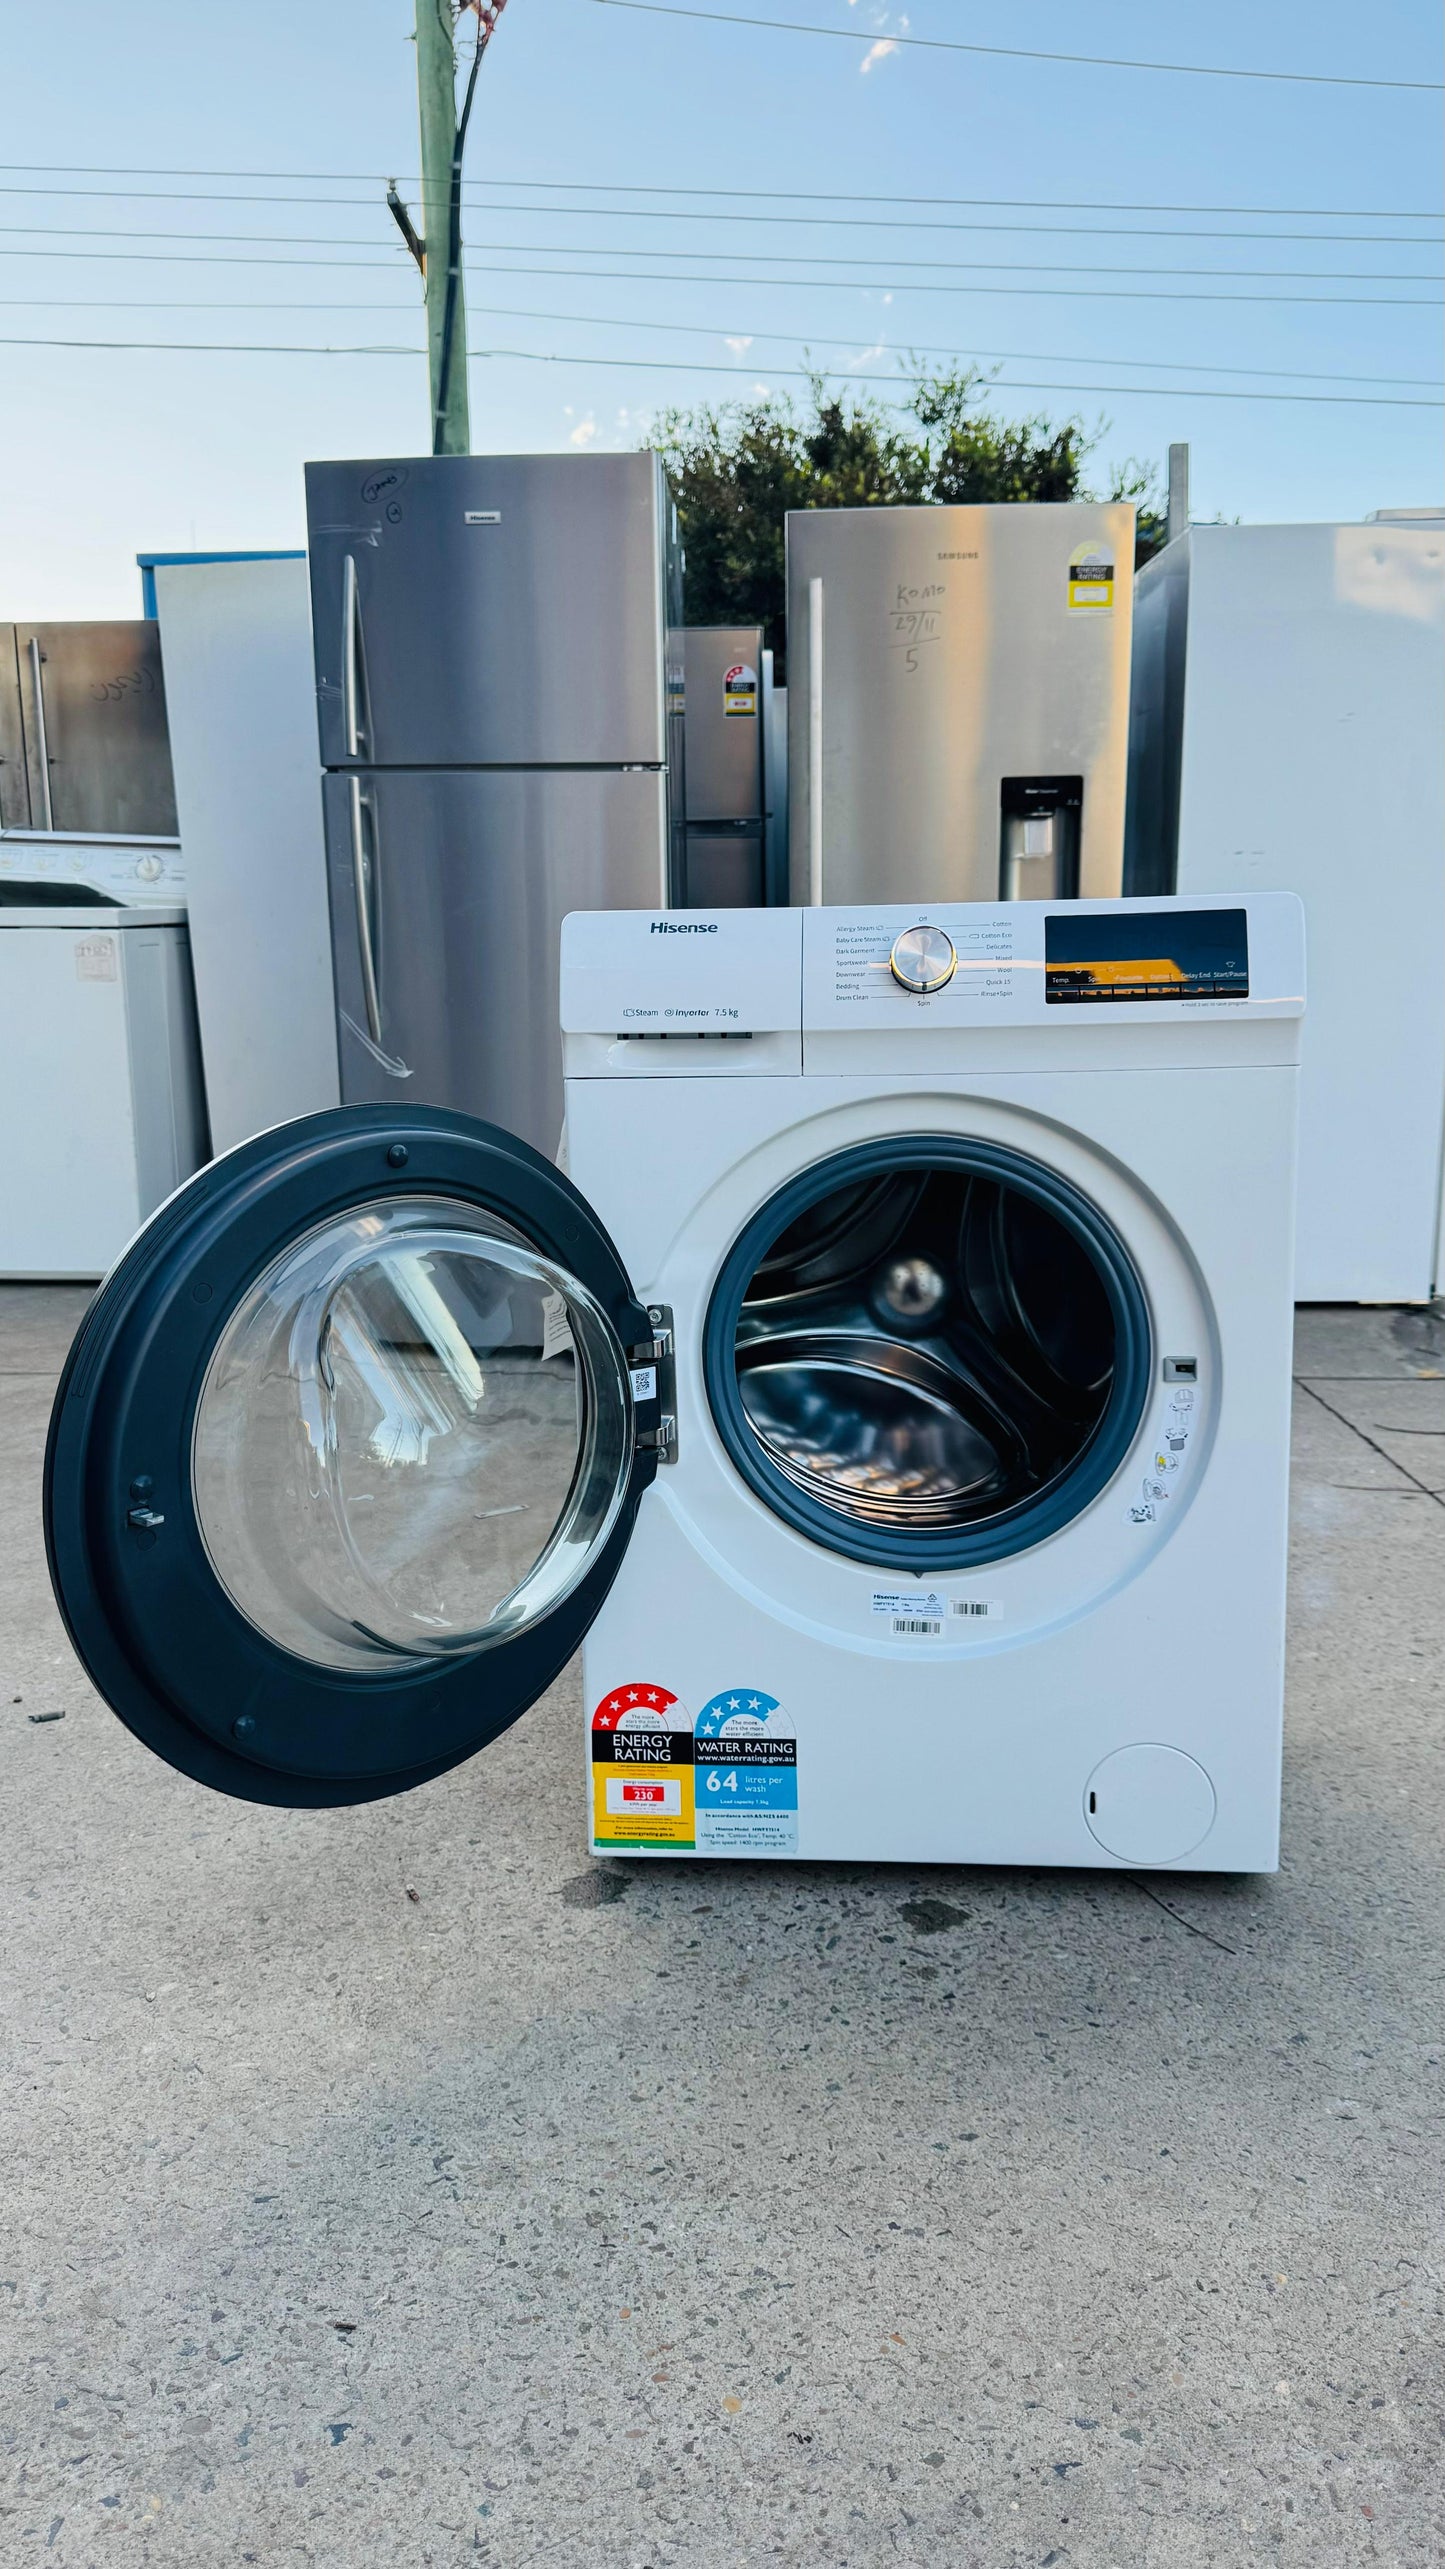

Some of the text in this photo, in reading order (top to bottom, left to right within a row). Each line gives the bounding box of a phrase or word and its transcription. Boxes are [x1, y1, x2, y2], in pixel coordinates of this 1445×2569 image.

[906, 648, 919, 673] 5
[650, 922, 718, 934] Hisense
[836, 936, 850, 944] Baby
[864, 934, 881, 942] Steam
[836, 983, 860, 991] Bedding
[981, 990, 1013, 998] Rinse+Spin
[636, 1008, 659, 1017] Steam
[715, 1008, 727, 1017] 7.5
[728, 1008, 739, 1018] kg
[613, 1734, 672, 1747] ENERGY
[697, 1742, 794, 1754] WATER RATING
[615, 1748, 671, 1761] RATING
[697, 1755, 795, 1764] www.waterrating.gov.au
[706, 1770, 738, 1792] 64
[768, 1777, 783, 1785] per
[634, 1791, 654, 1800] 230
